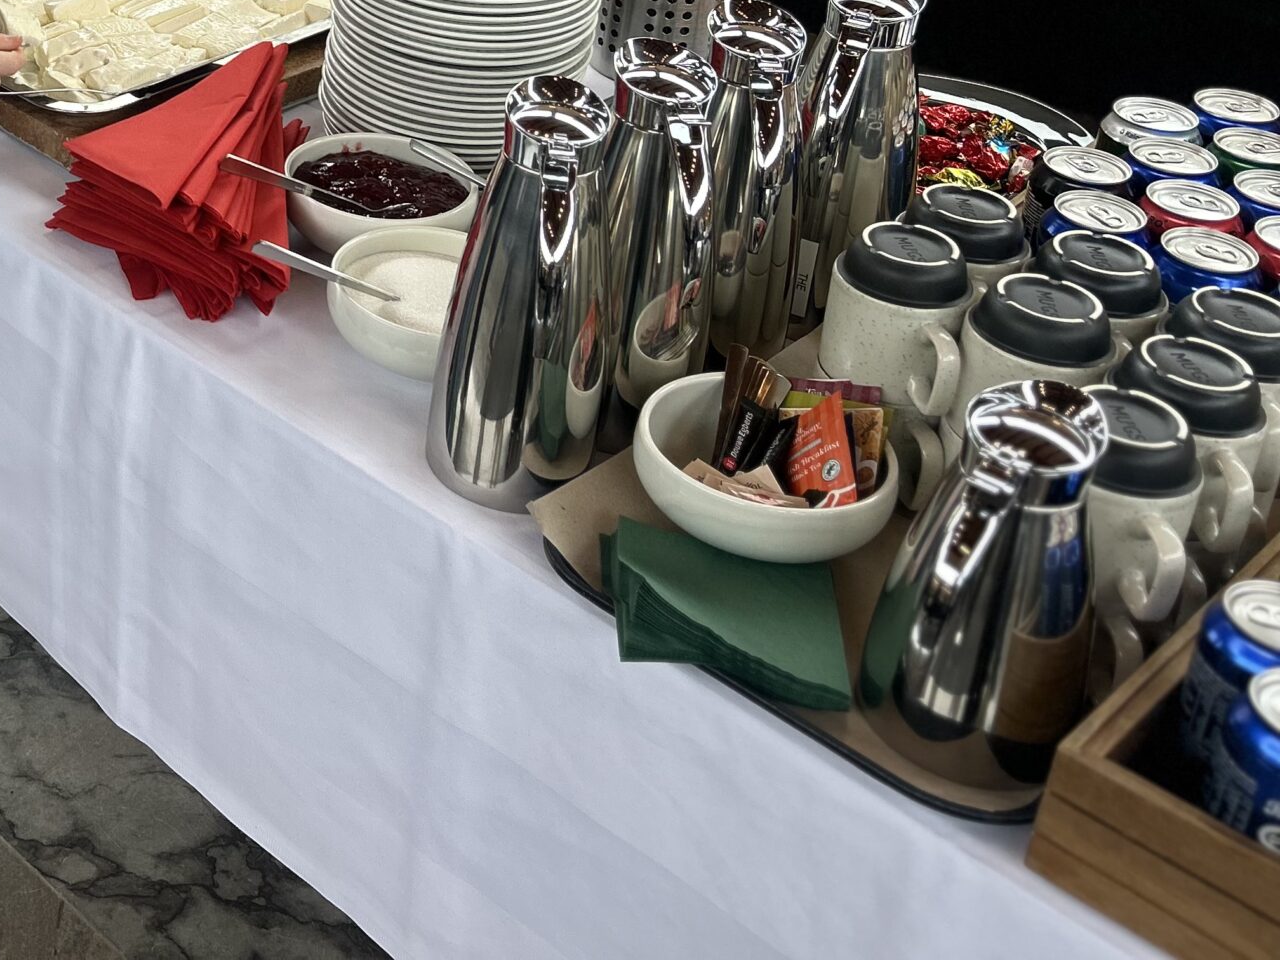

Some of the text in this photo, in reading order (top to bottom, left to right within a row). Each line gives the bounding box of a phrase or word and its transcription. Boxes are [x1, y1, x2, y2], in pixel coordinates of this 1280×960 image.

[796, 273, 809, 292] THE
[730, 411, 754, 458] Douwe Egberts
[800, 440, 841, 466] Breakfast
